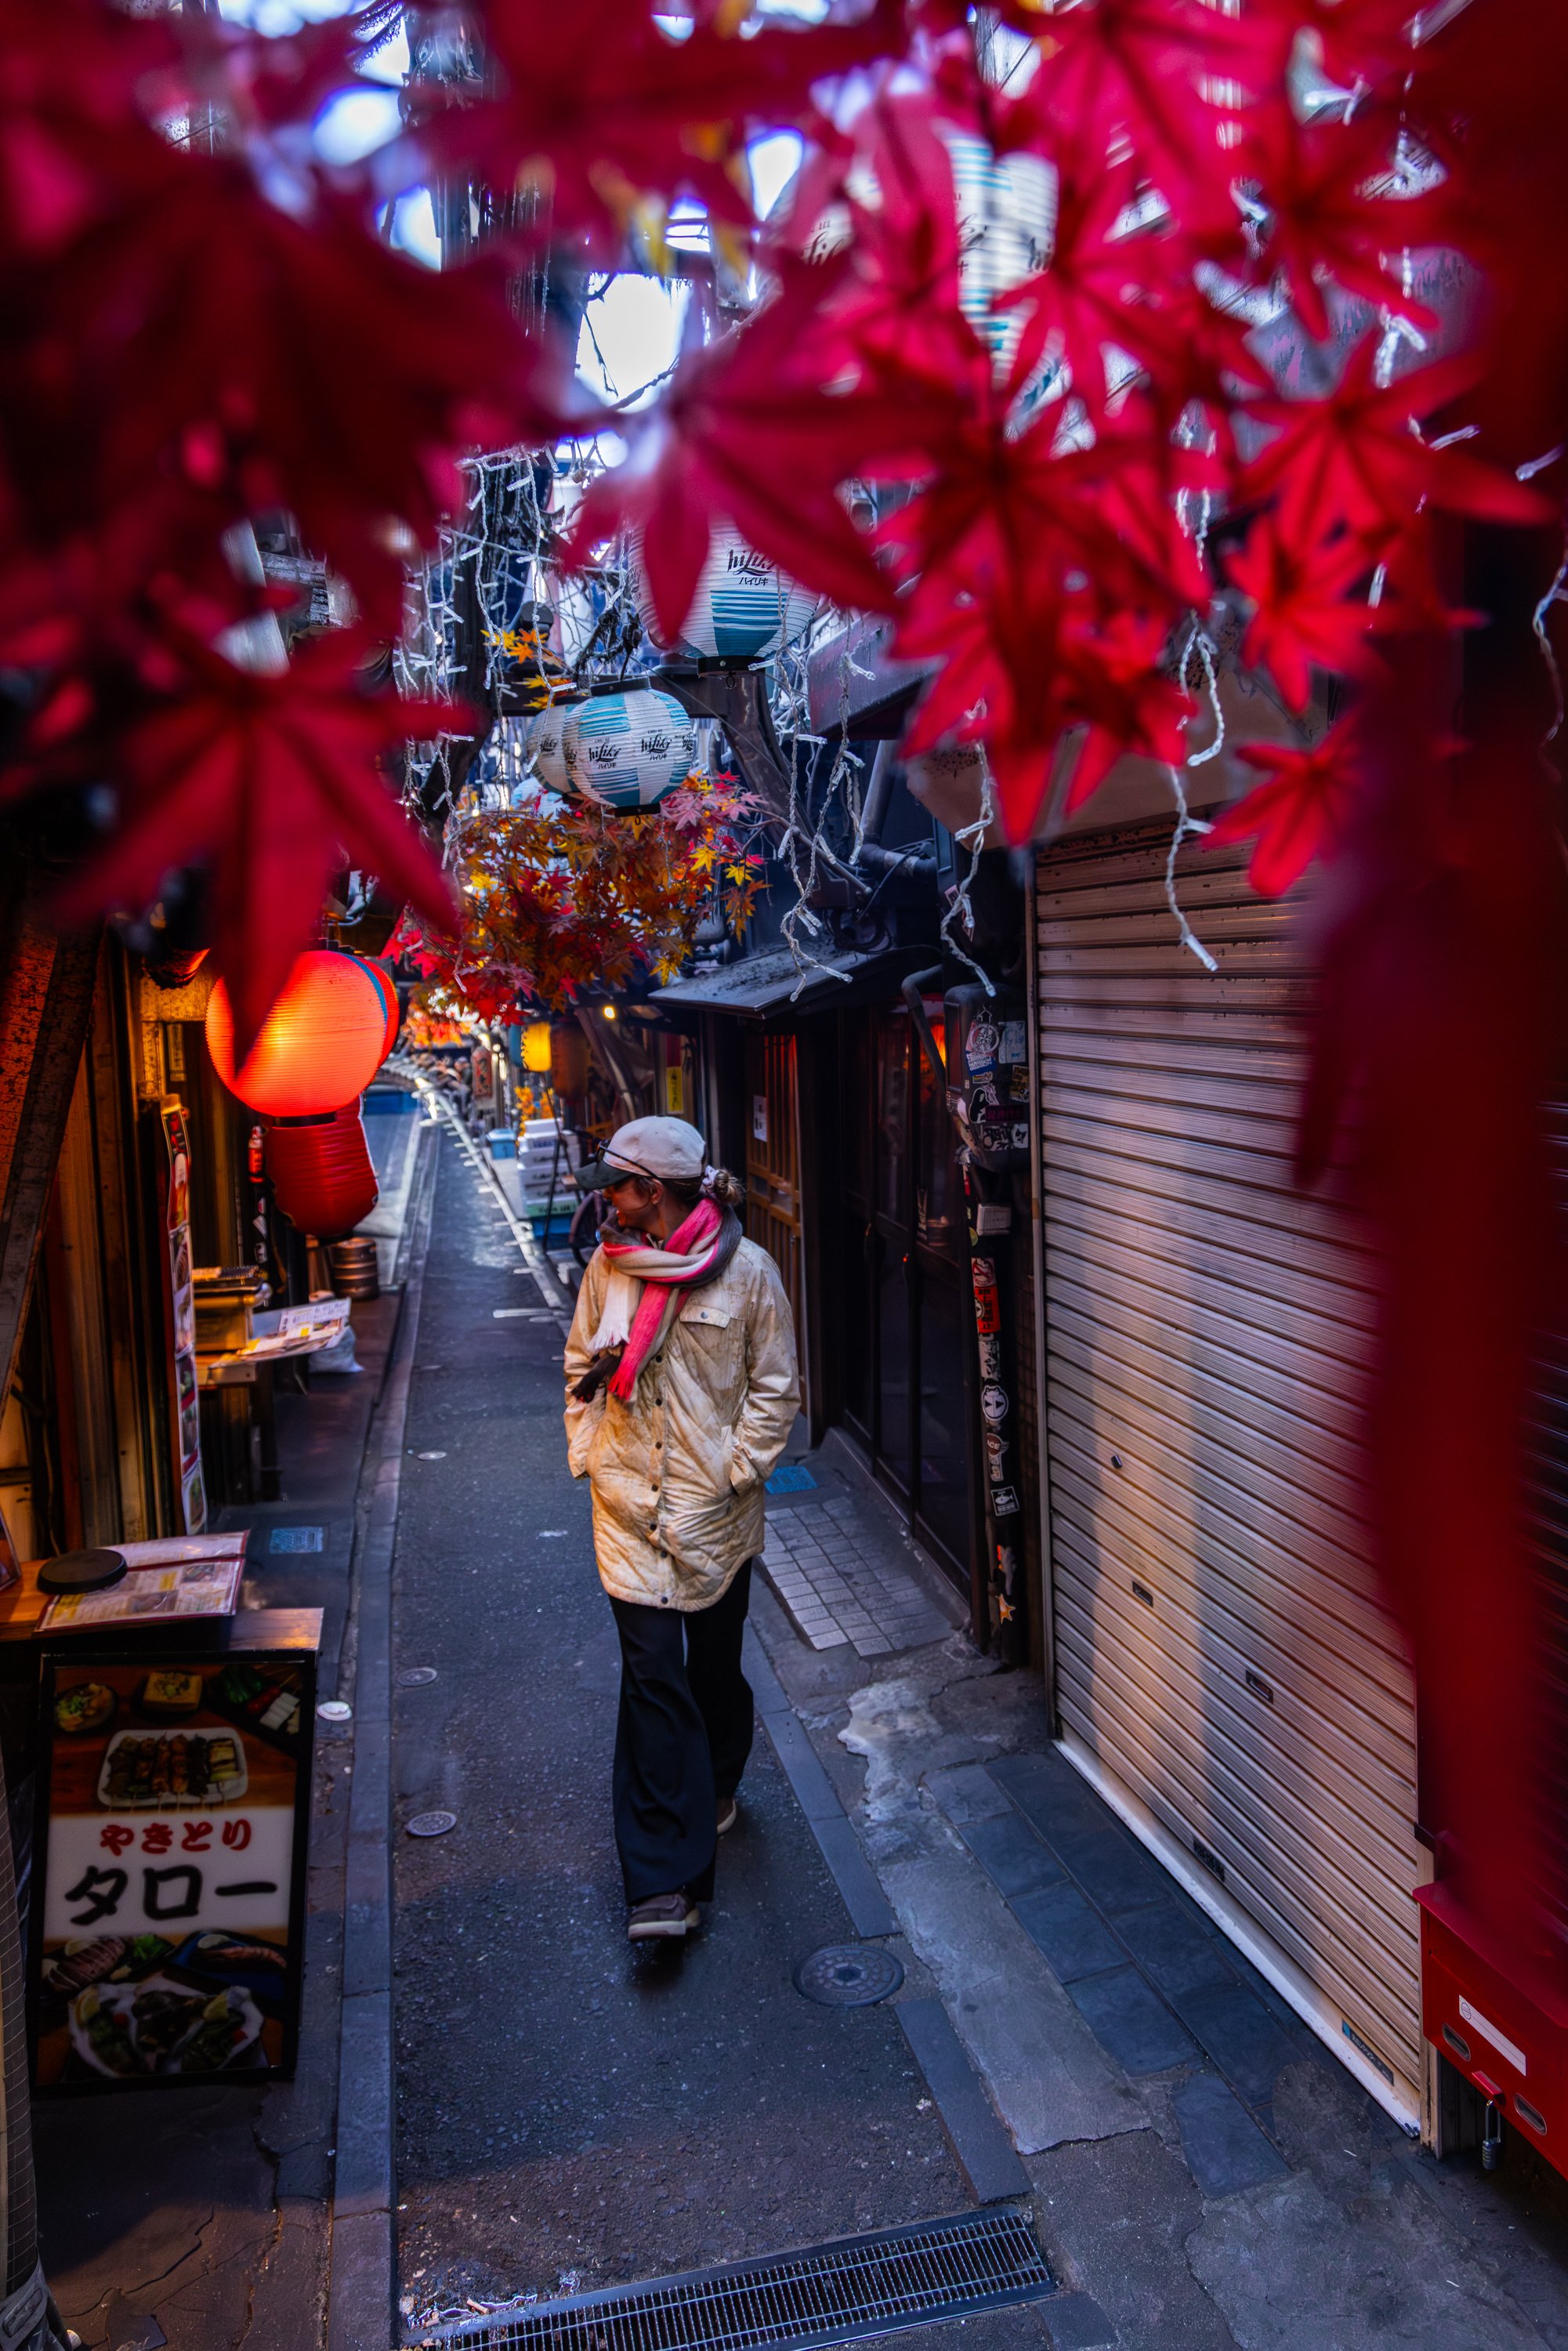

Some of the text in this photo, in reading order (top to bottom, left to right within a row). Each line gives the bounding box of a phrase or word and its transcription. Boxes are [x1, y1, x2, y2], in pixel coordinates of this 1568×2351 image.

[739, 577, 770, 586] ハイリキ
[100, 1818, 252, 1856] やきとり
[64, 1864, 278, 1926] タロー
